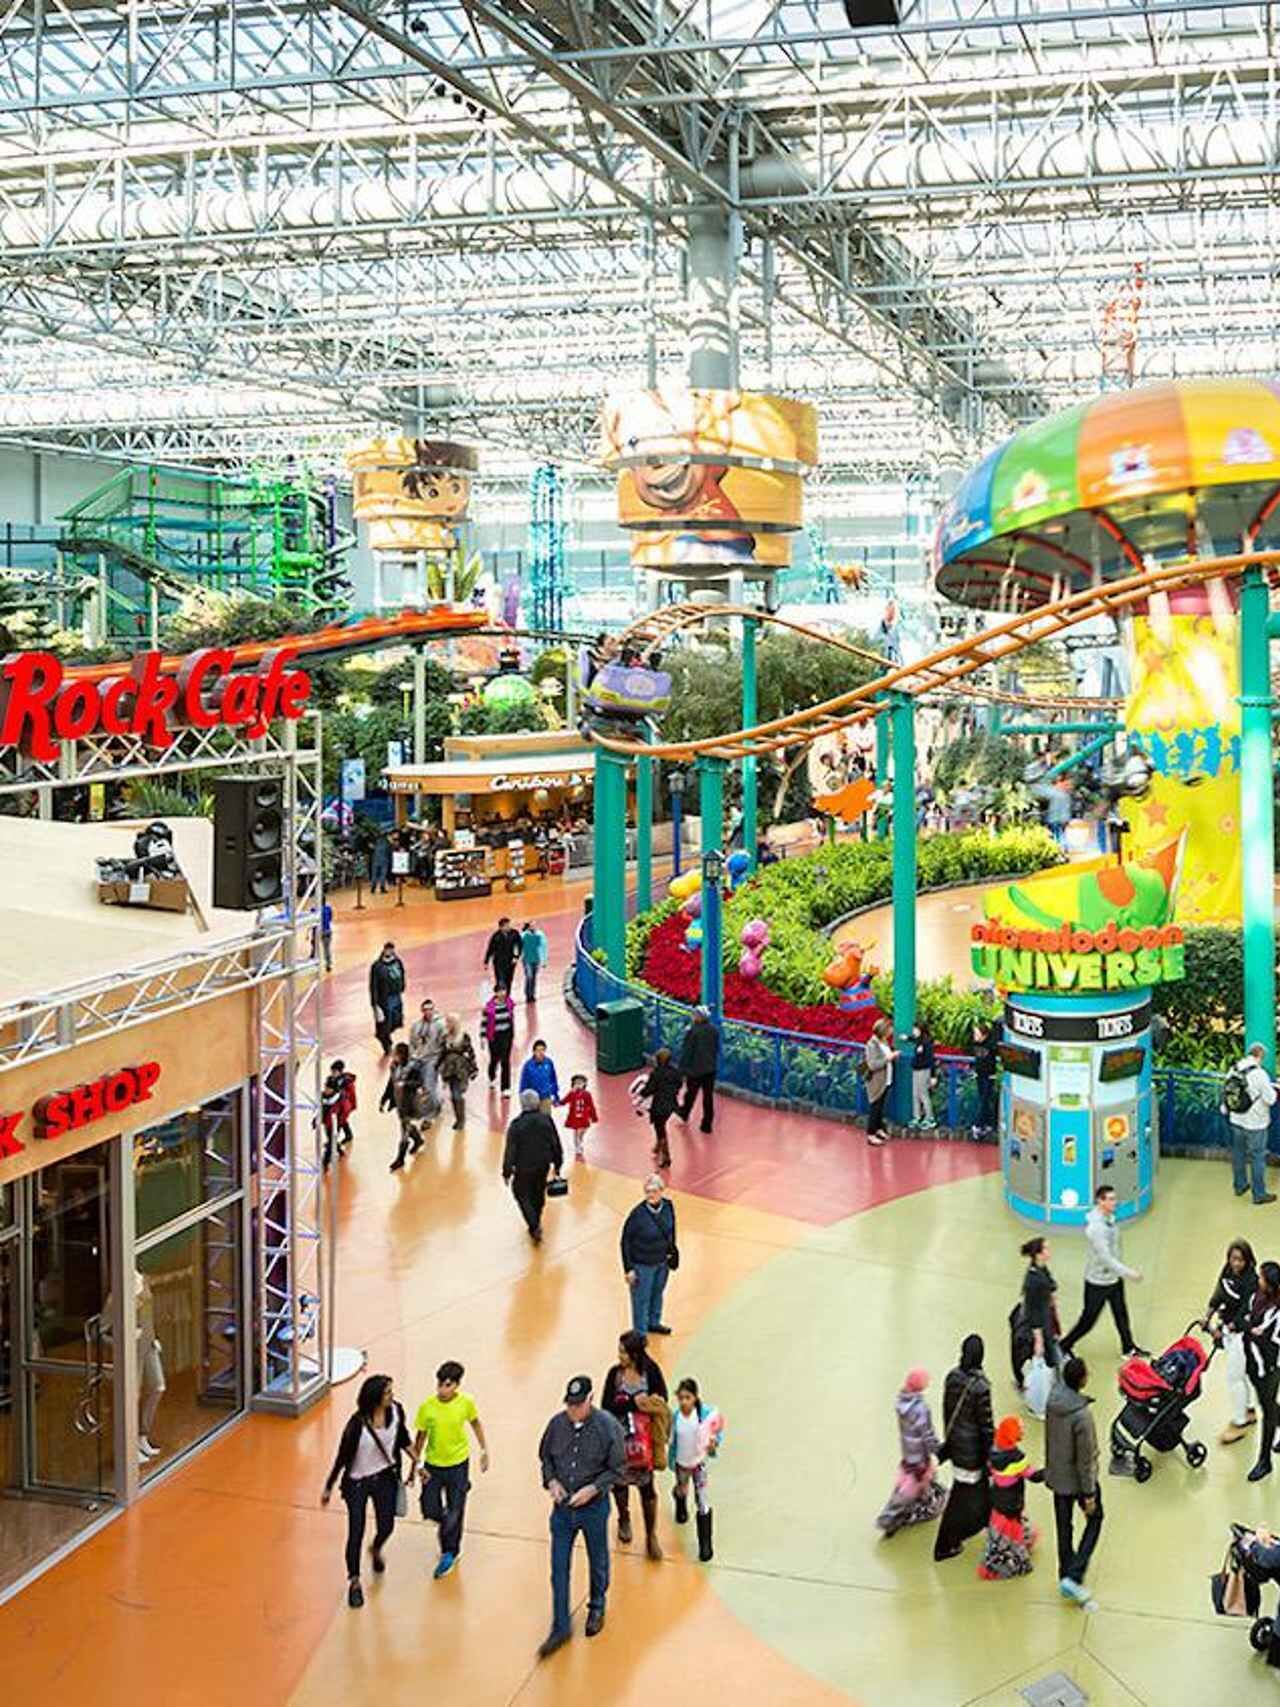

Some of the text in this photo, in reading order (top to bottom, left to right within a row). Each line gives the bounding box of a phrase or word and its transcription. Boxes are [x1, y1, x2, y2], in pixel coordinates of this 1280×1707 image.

[0, 648, 312, 762] Rock Cafe
[971, 915, 1184, 954] nickelodeon
[971, 943, 1185, 990] UNIVERSE
[38, 1062, 160, 1140] SHOP
